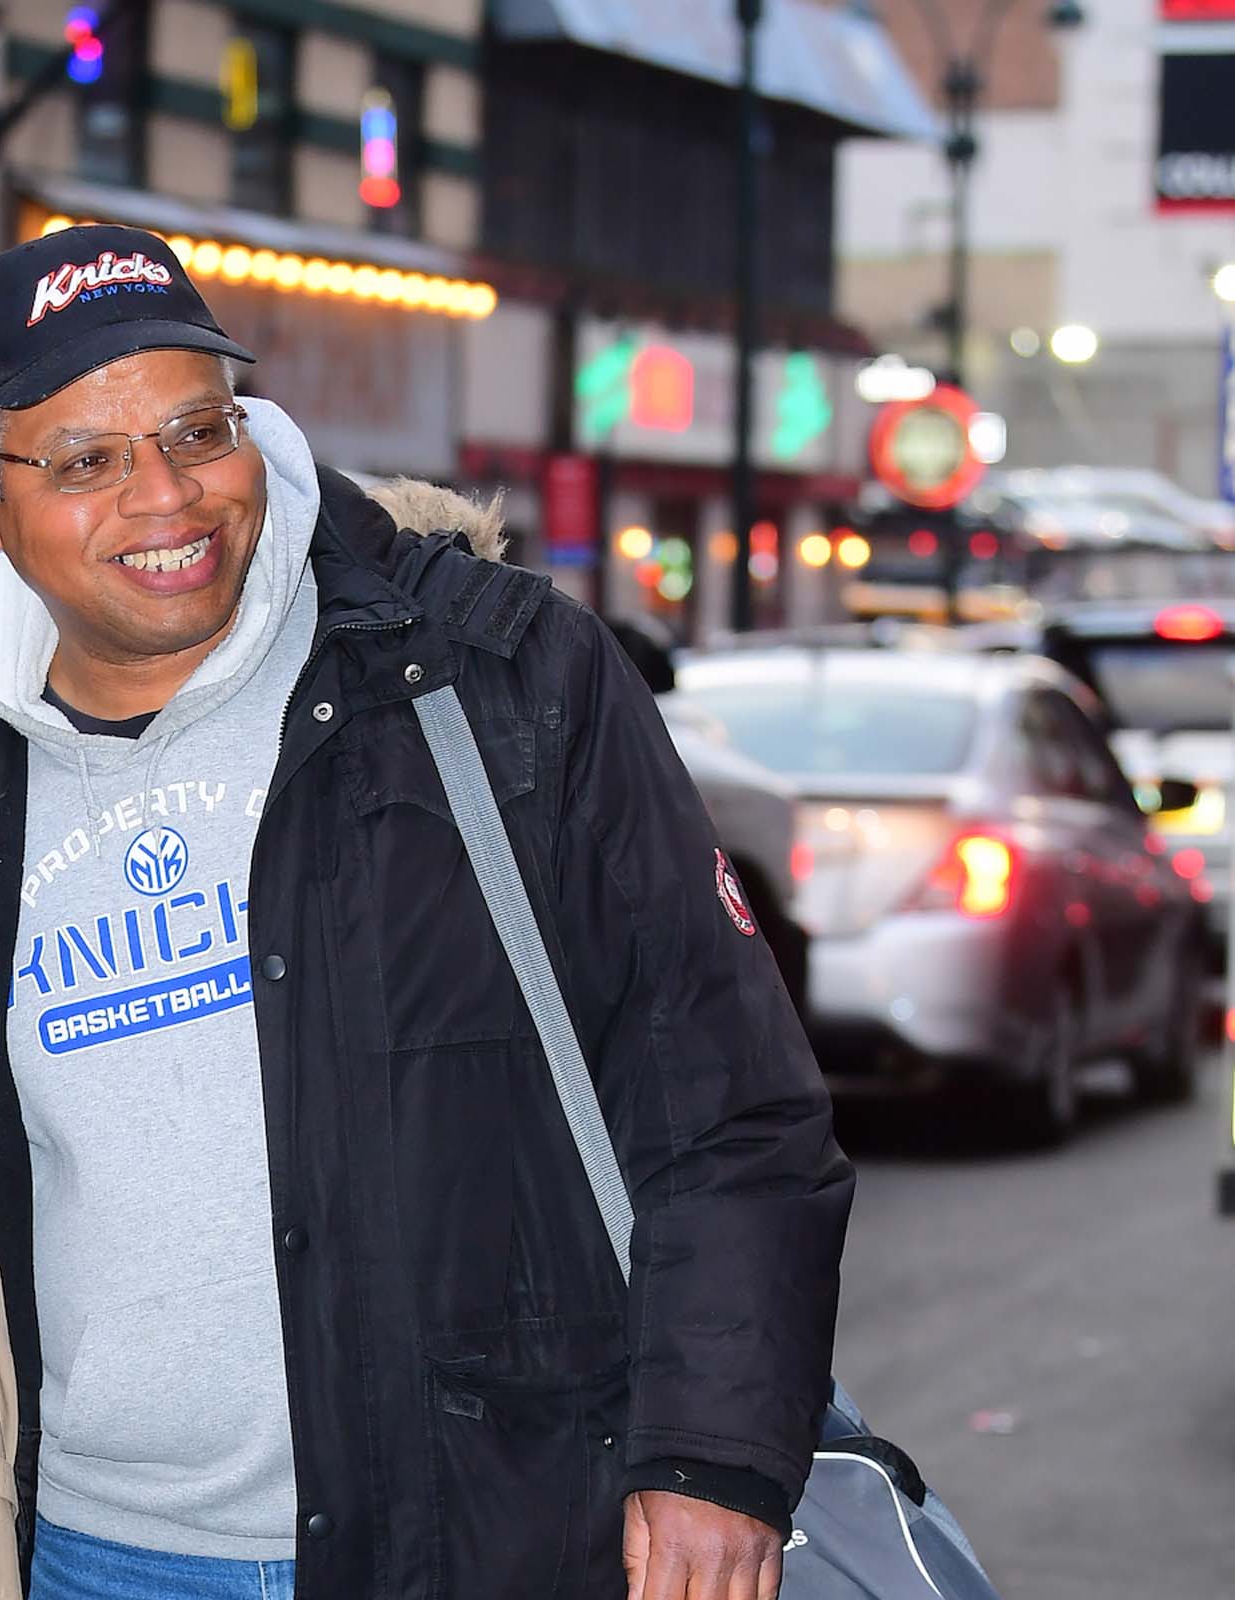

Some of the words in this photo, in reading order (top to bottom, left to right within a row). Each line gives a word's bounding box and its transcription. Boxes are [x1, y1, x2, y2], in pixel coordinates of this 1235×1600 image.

[27, 252, 174, 328] Knicks
[80, 284, 118, 303] NEW
[122, 283, 169, 296] YORK
[21, 781, 226, 908] PROPERTY
[46, 973, 251, 1044] BASKETBALL
